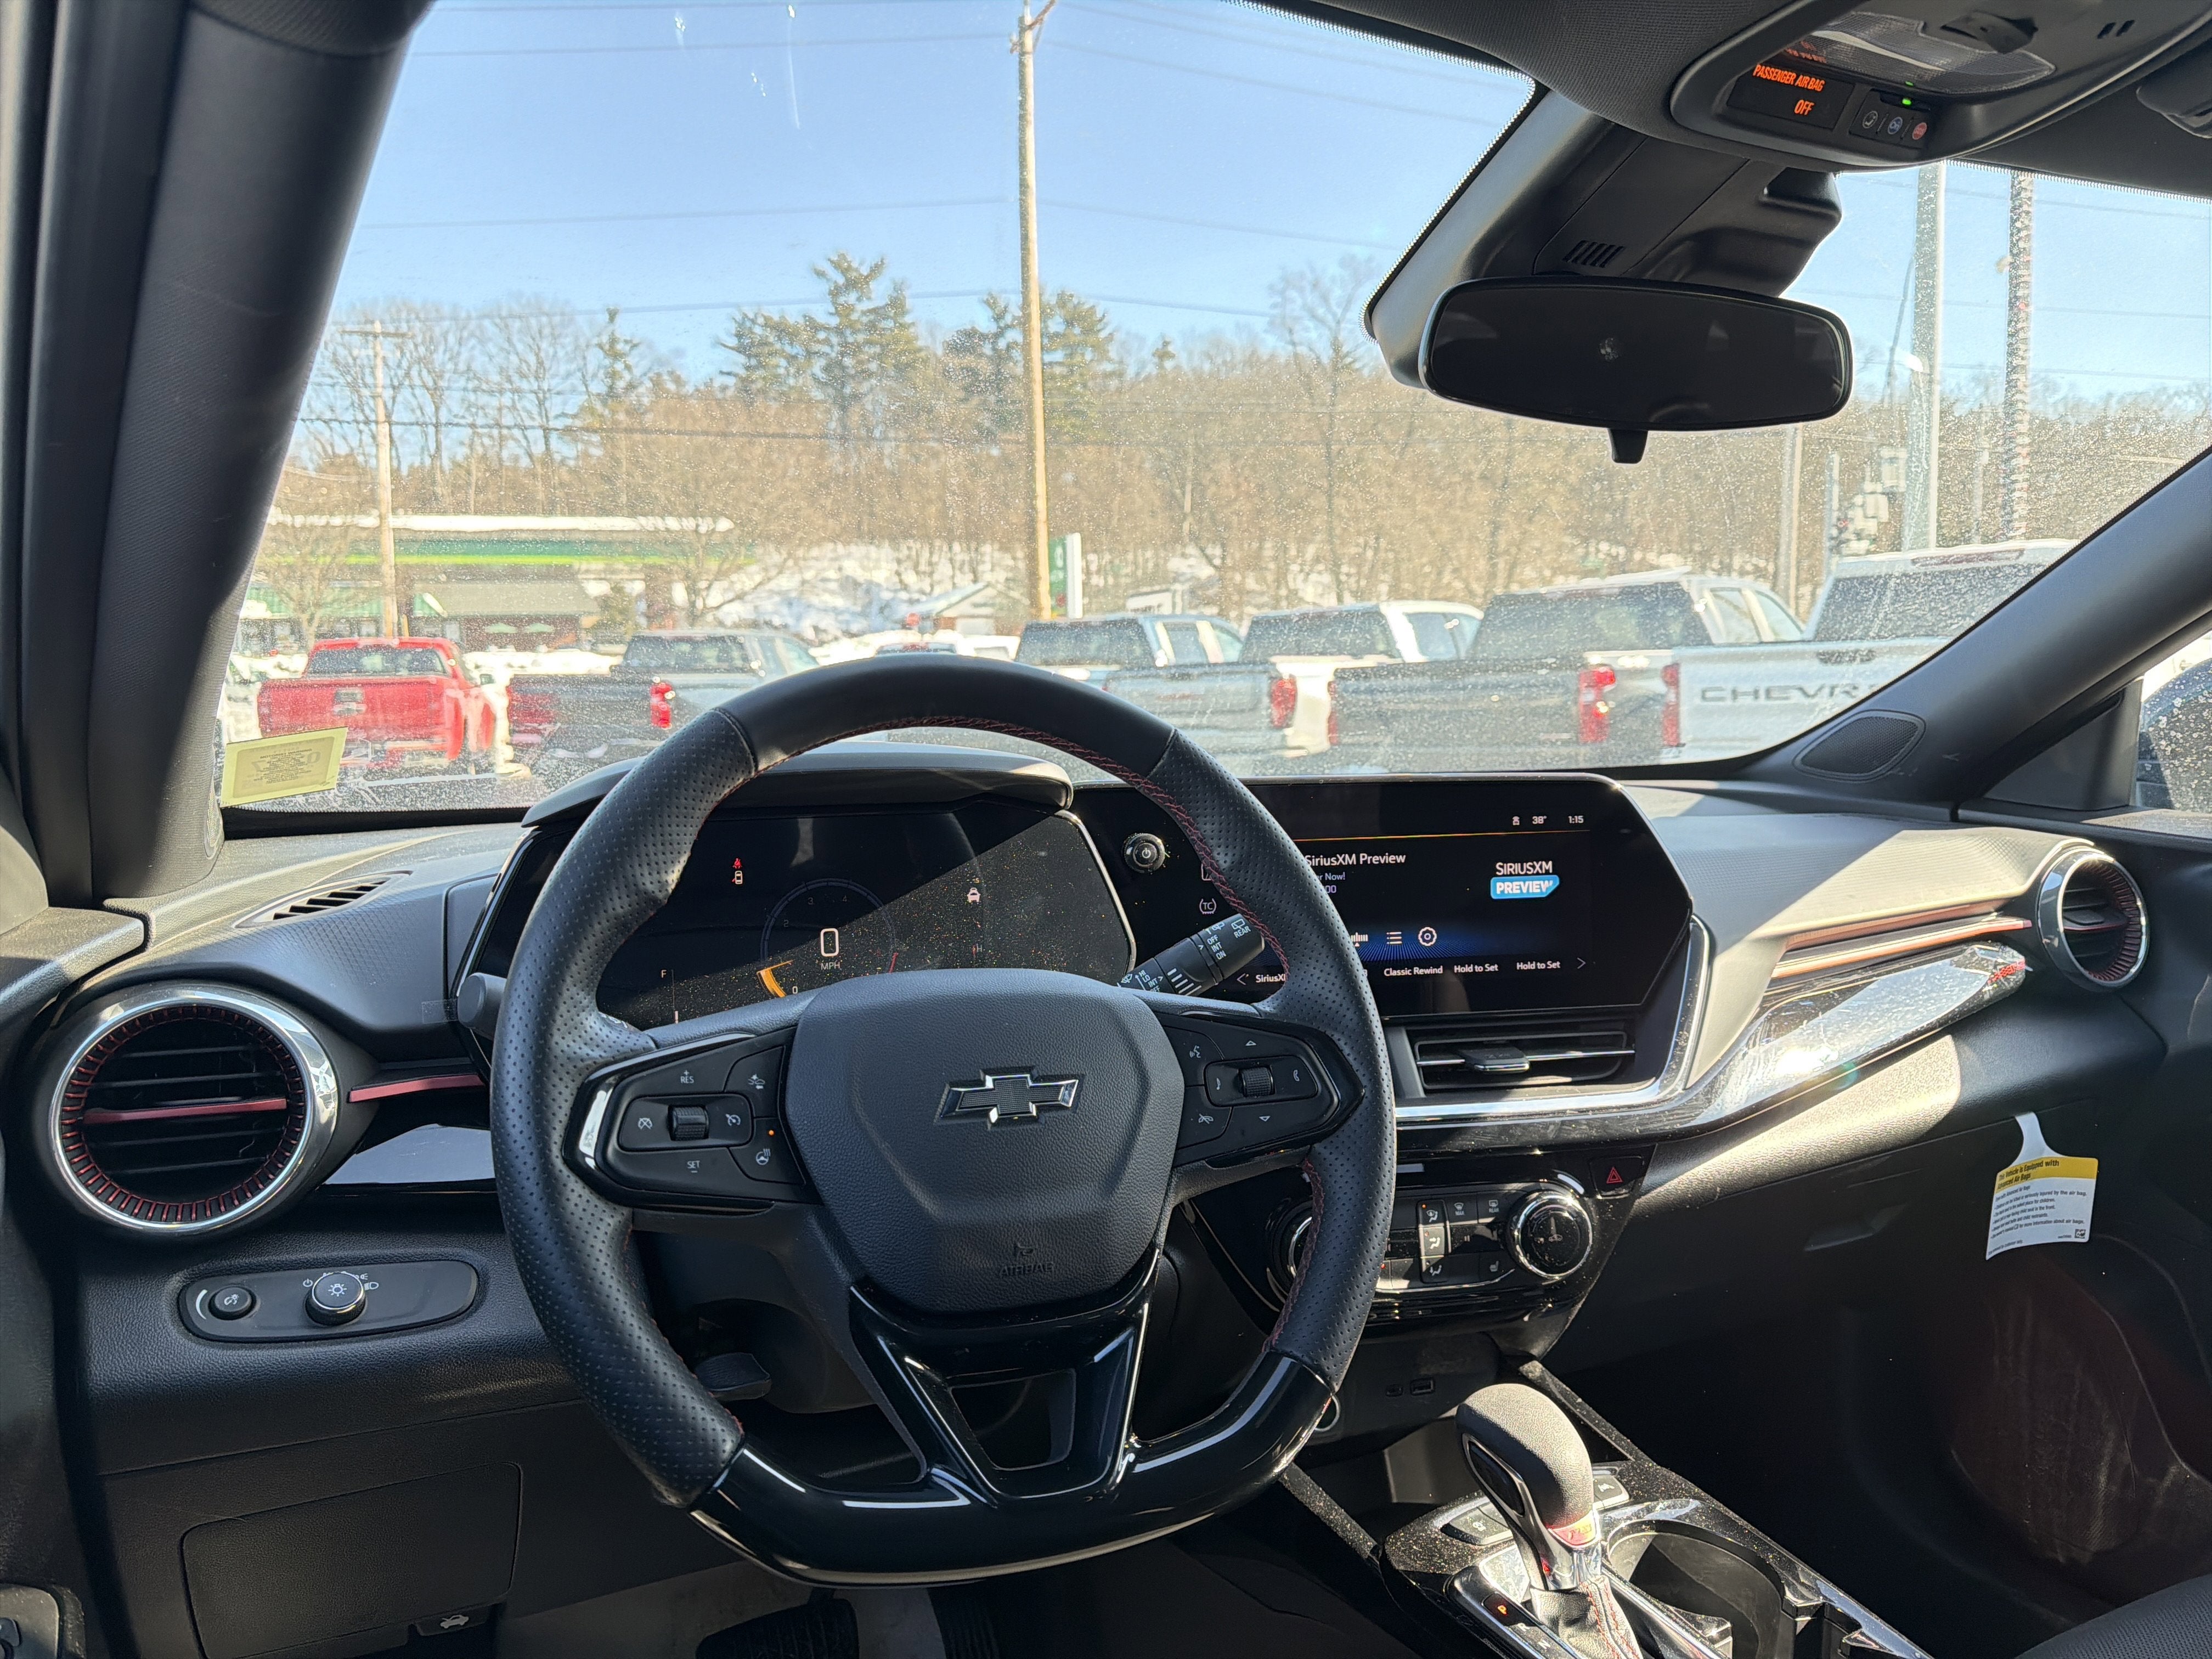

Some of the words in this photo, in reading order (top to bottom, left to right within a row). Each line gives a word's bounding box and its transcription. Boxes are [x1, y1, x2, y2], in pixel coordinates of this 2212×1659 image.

[1753, 64, 1796, 86] PASSENGER
[1794, 99, 1815, 116] OFF
[1701, 682, 1878, 702] CHEVR
[1568, 815, 1584, 823] 1:15
[1305, 854, 1356, 866] SiriusXM
[1359, 853, 1406, 865] Preview
[1496, 861, 1553, 876] SIRIUSXM
[1325, 872, 1346, 881] Now!
[1496, 880, 1554, 894] PREVIEW
[1203, 902, 1214, 910] TC
[1233, 926, 1251, 939] REAR
[820, 928, 839, 957] 0
[1207, 935, 1218, 945] OFF
[1211, 943, 1222, 953] INT
[1216, 950, 1226, 960] ON
[821, 962, 840, 970] MPH
[1454, 964, 1474, 973] Hold
[1485, 964, 1499, 972] Set
[1516, 961, 1536, 970] Hold
[1547, 961, 1561, 969] Set
[661, 970, 667, 978] F
[1384, 967, 1412, 977] Classic
[1413, 965, 1443, 975] Rewind
[1148, 978, 1158, 988] INT
[680, 1075, 695, 1084] RES
[687, 1160, 700, 1169] SET
[1497, 1605, 1507, 1616] P
[1518, 1622, 1530, 1632] R
[1538, 1639, 1551, 1650] N
